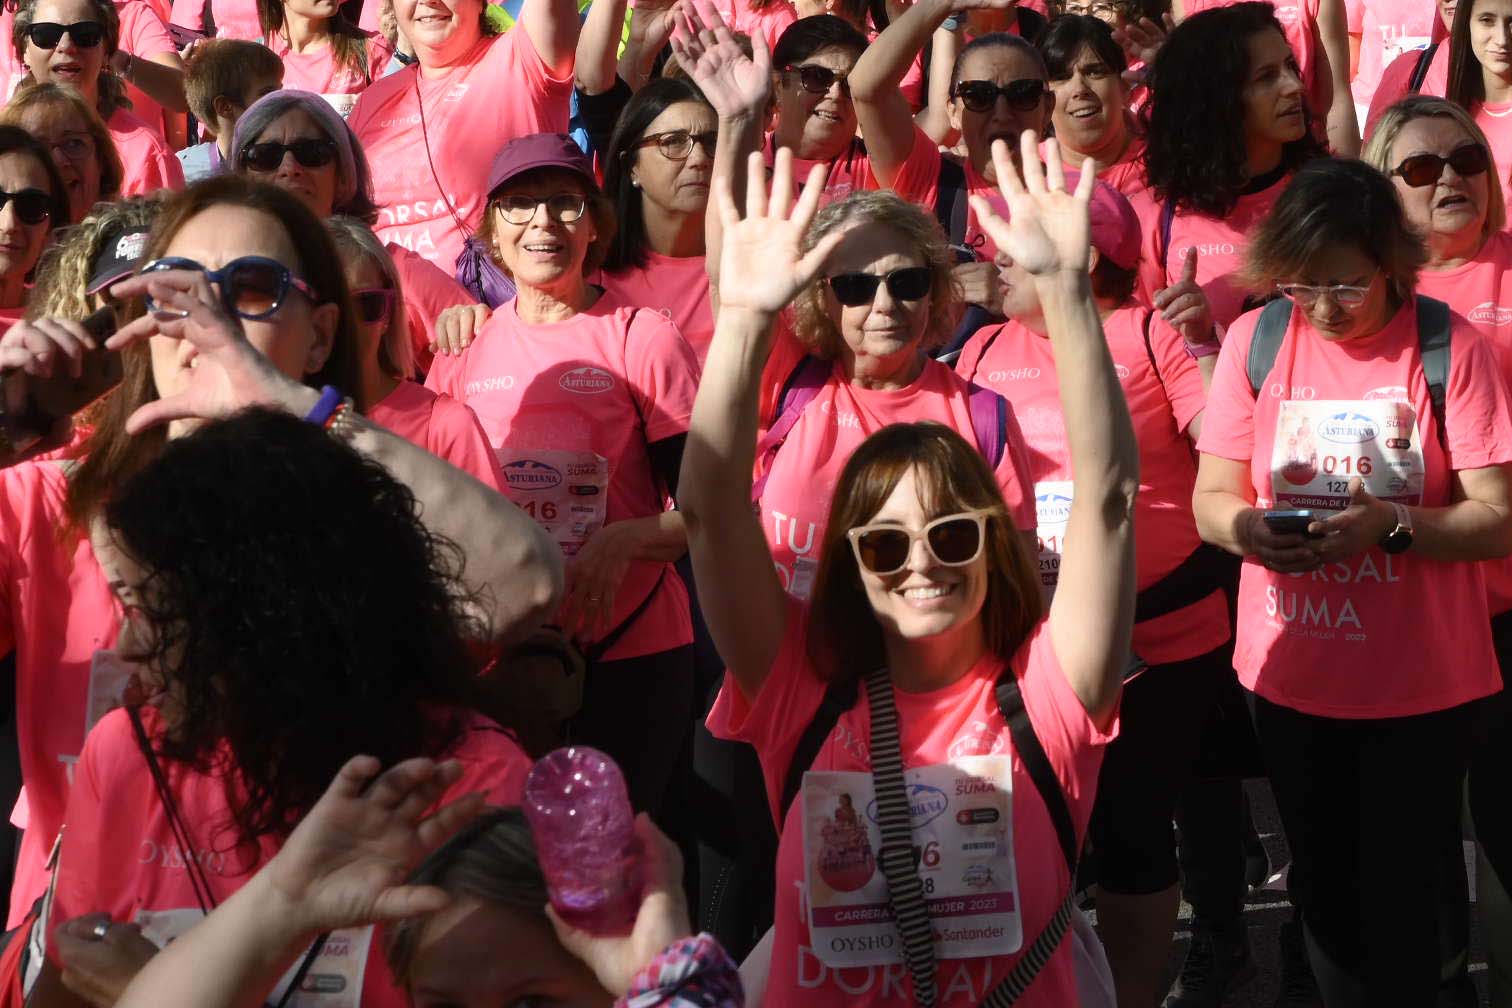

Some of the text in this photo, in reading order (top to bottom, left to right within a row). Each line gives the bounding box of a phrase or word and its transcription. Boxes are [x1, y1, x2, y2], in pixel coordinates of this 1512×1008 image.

[988, 367, 1041, 384] OYSHO
[1322, 455, 1373, 476] 016
[1290, 497, 1341, 507] CARRERA DE
[771, 511, 816, 555] TU
[1265, 584, 1362, 629] SUMA
[955, 782, 996, 796] SUMA
[834, 908, 889, 922] CARRERA
[969, 898, 997, 911] 2023
[831, 925, 1004, 954] OYSHO Santander
